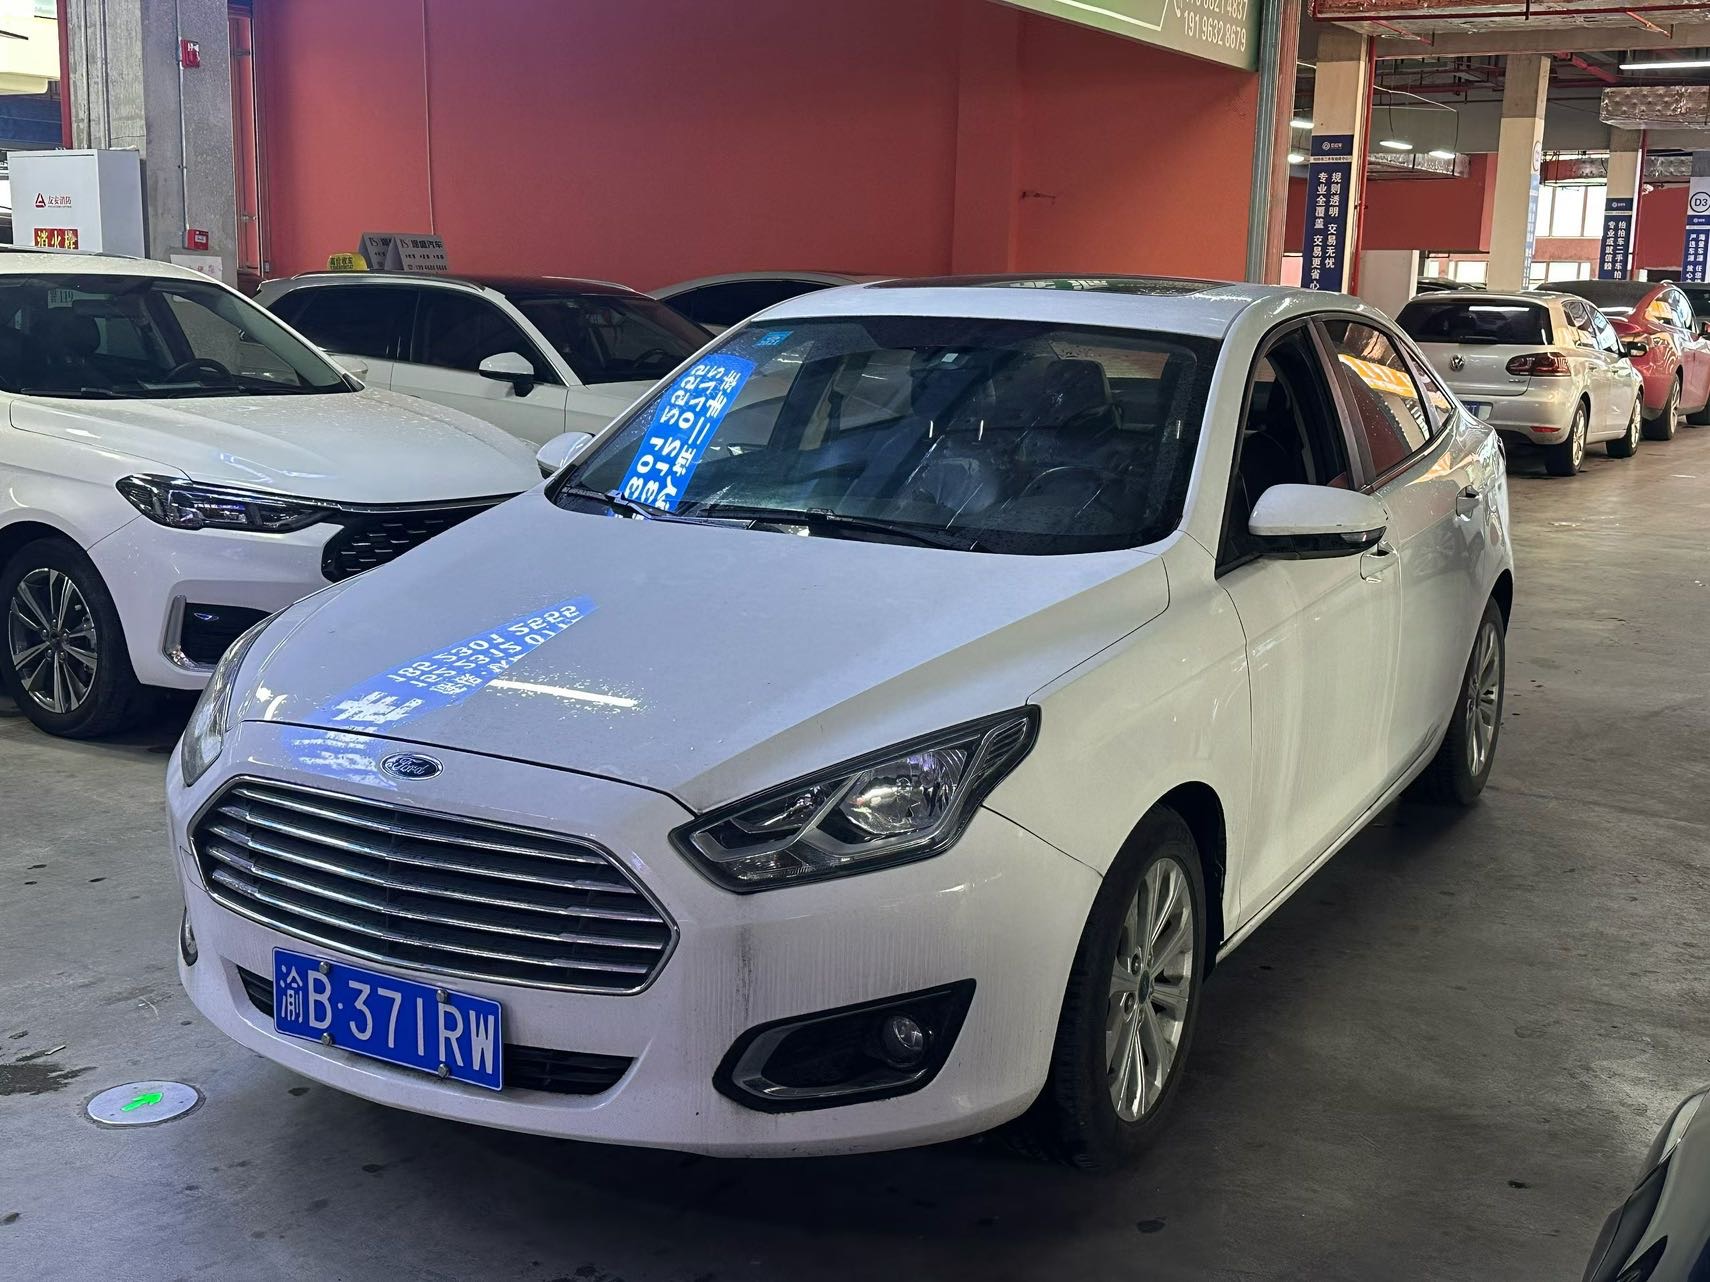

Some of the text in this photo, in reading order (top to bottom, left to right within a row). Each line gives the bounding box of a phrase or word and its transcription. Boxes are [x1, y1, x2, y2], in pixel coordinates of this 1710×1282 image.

[1183, 10, 1247, 52] 191 9632 8679
[1226, 0, 1248, 21] 4837
[1325, 172, 1342, 268] 规则透明 交易无忧
[1694, 198, 1708, 207] D3
[1310, 172, 1328, 290] 专业全覆盖 交易更省心
[386, 757, 430, 776] Ford
[279, 964, 496, 1075] 渝B·371RW
